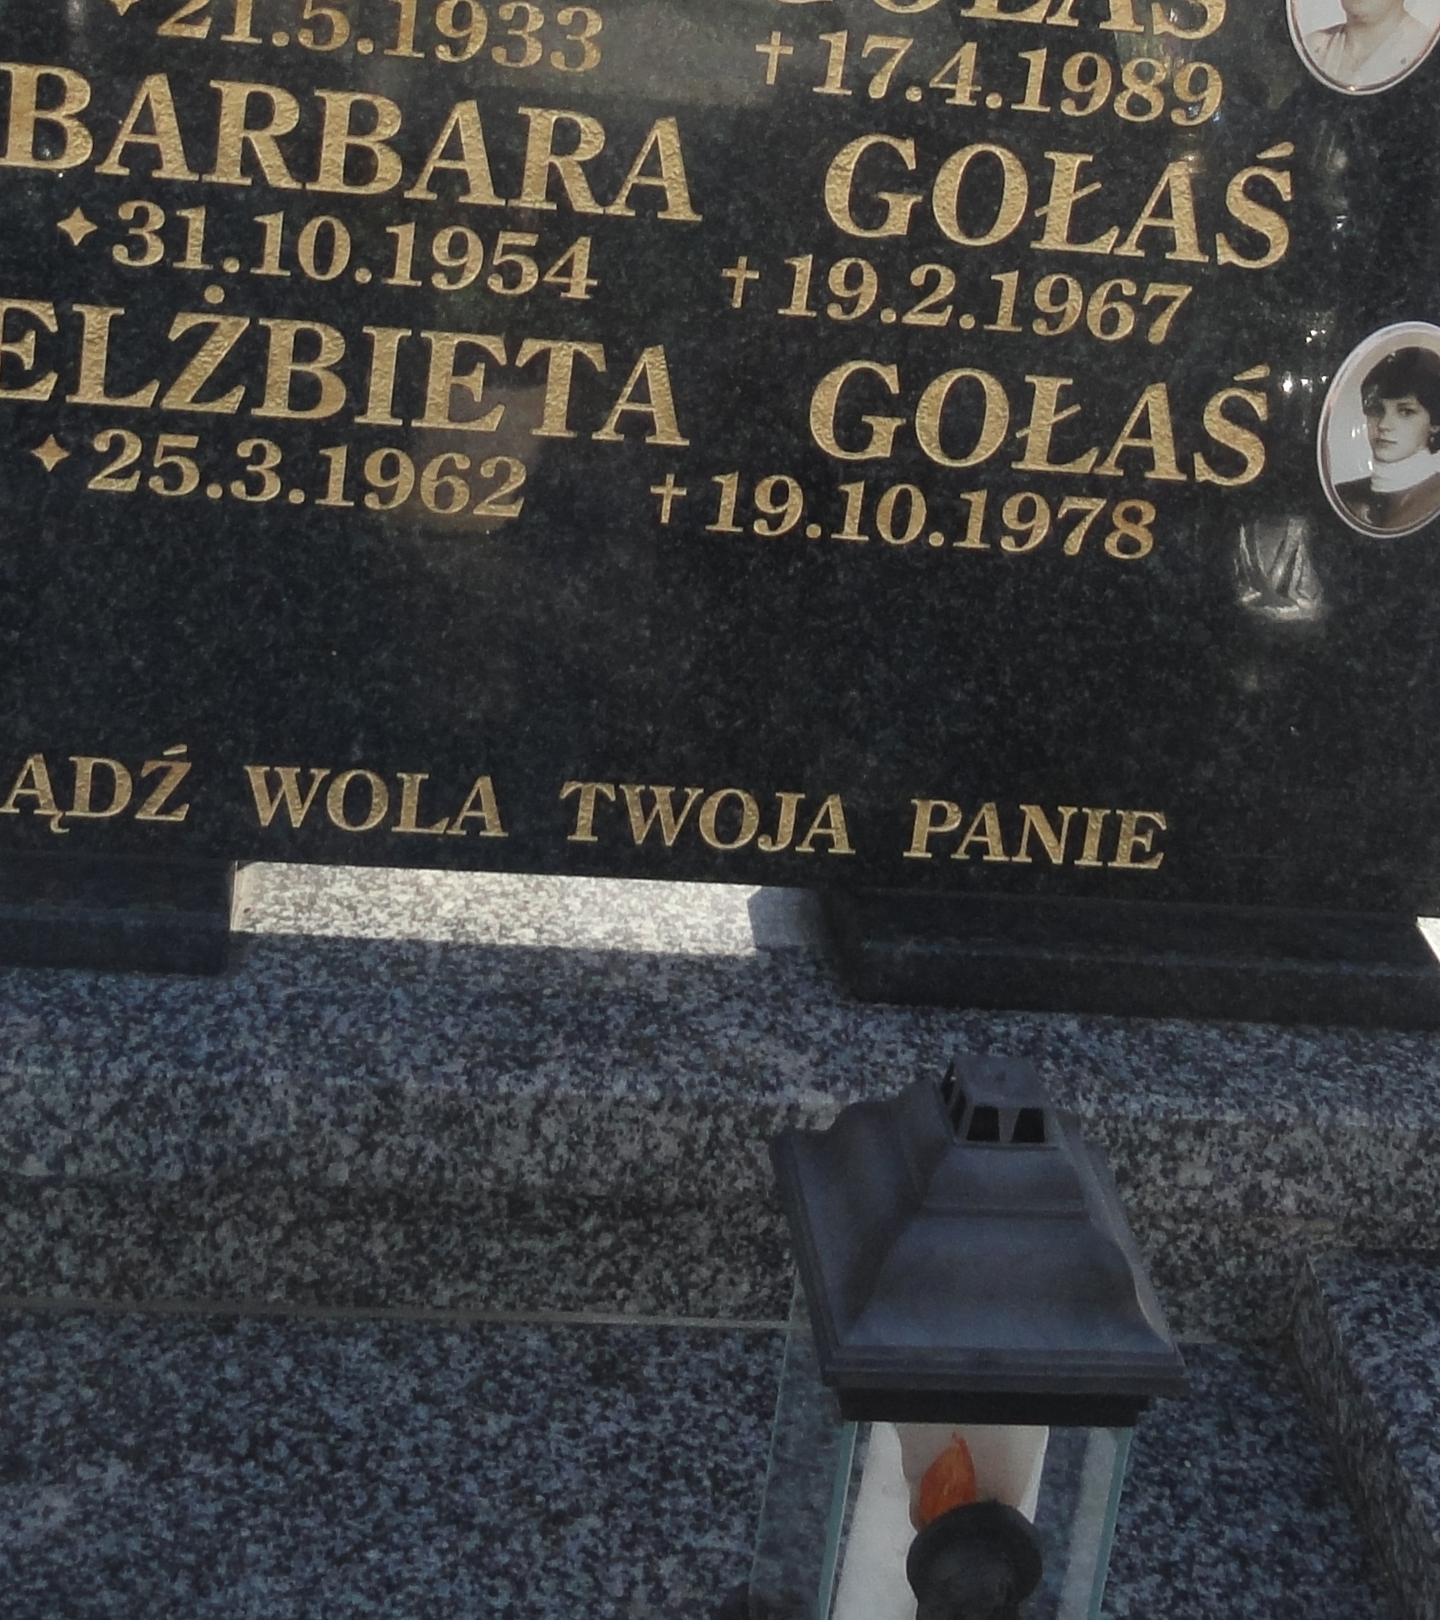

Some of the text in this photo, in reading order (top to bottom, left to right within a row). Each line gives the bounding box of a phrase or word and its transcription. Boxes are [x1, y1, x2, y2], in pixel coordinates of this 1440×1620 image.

[812, 30, 1225, 127] 17.4.1989
[822, 133, 1296, 269] GOŁAŚ
[111, 200, 1193, 346] 31.10.1954 19.2.1967
[809, 361, 1271, 488] GOŁAŚ
[87, 428, 1157, 561] 25.3.1962 19.10.1978
[243, 763, 509, 839] WOLA
[560, 780, 854, 856] TWOJA
[902, 798, 1167, 870] PANIE
